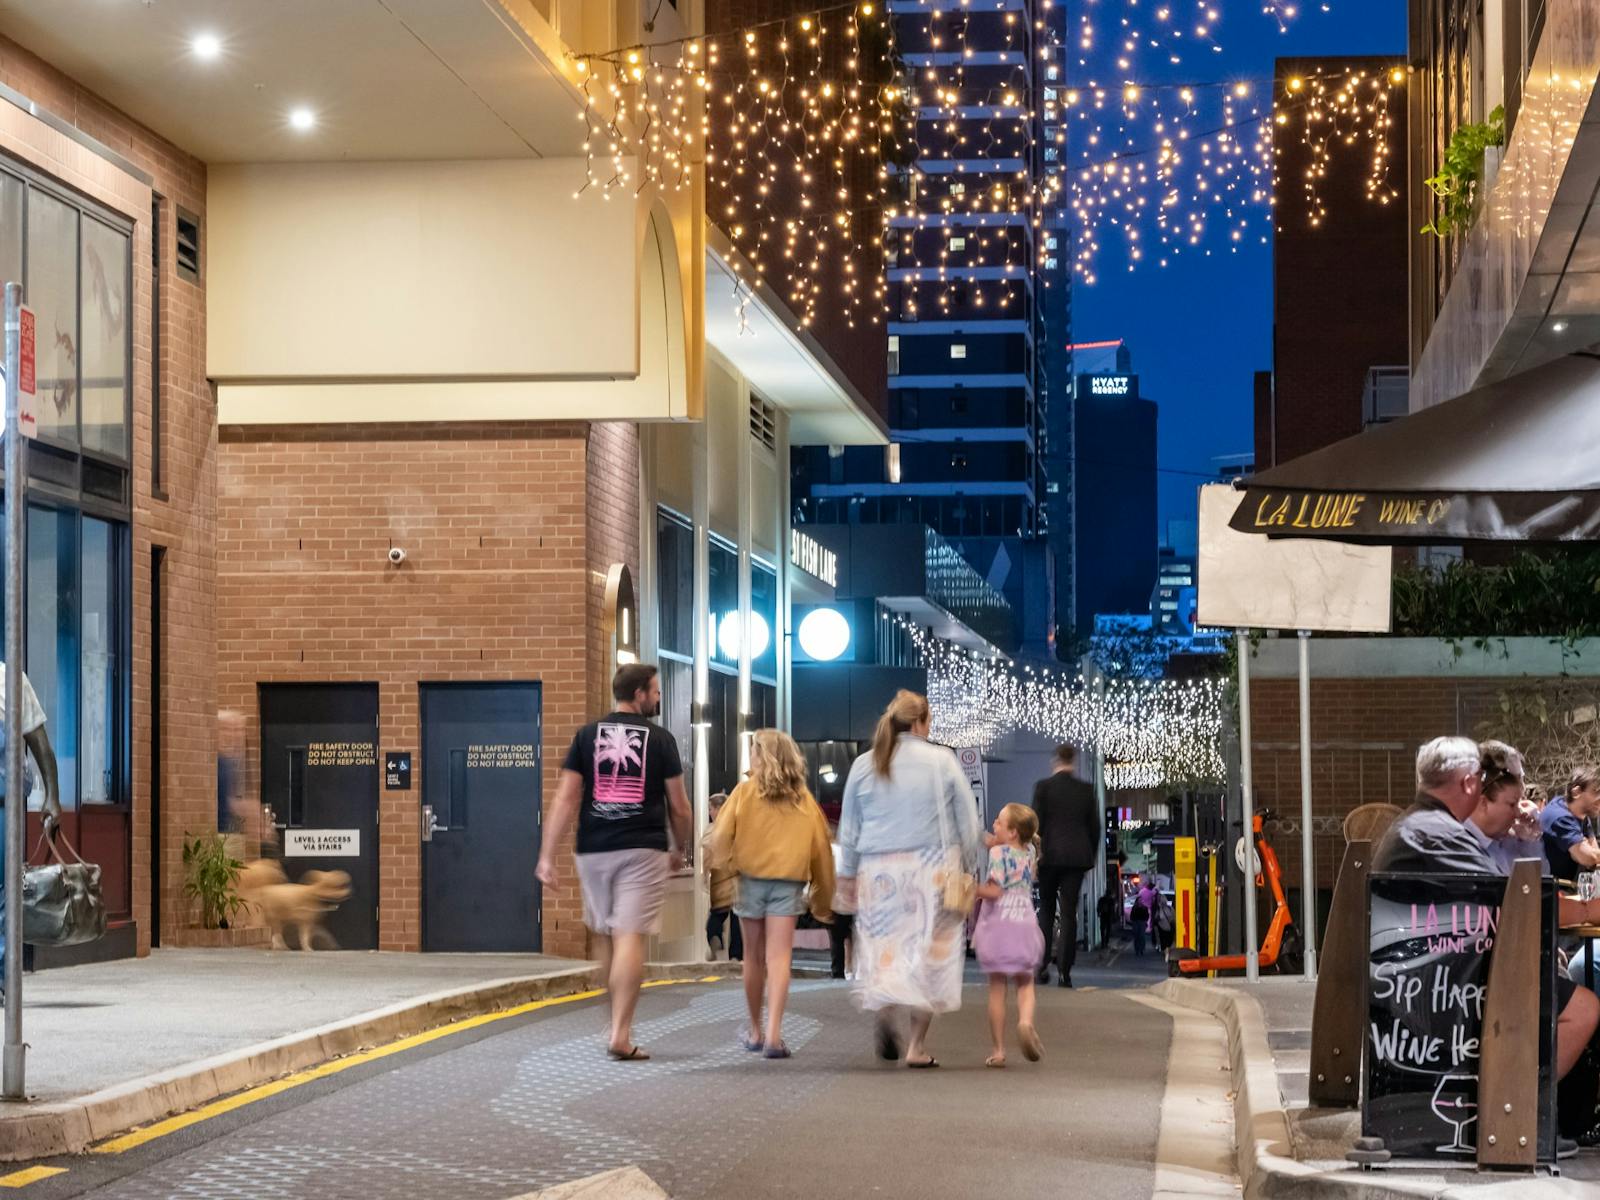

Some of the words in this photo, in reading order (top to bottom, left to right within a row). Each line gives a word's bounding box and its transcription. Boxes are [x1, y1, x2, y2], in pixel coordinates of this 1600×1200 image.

[1092, 377, 1128, 387] HYATT
[1092, 386, 1128, 394] REGENCY
[1254, 494, 1290, 526] LA
[1292, 493, 1366, 528] LUNE
[1378, 499, 1427, 525] WINE
[802, 532, 818, 577] FISH
[819, 545, 837, 588] LANE
[468, 744, 484, 752] FIRE
[484, 744, 510, 752] SAFETY
[510, 744, 533, 752] DOOR
[308, 750, 320, 758] DO
[321, 750, 336, 758] NOT
[337, 750, 374, 758] OBSTRUCT
[467, 752, 479, 760] DO
[480, 752, 496, 760] NOT
[496, 752, 534, 760] OBSTRUCT
[307, 758, 319, 766] DO
[320, 758, 336, 766] NOT
[336, 758, 355, 766] KEEP
[355, 758, 376, 766] OPEN
[466, 760, 479, 768] DO
[479, 760, 495, 768] NOT
[495, 760, 514, 768] KEEP
[514, 760, 535, 768] OPEN
[1451, 905, 1501, 937] LUN
[1427, 937, 1466, 954] WINE
[1451, 1023, 1481, 1066] He
